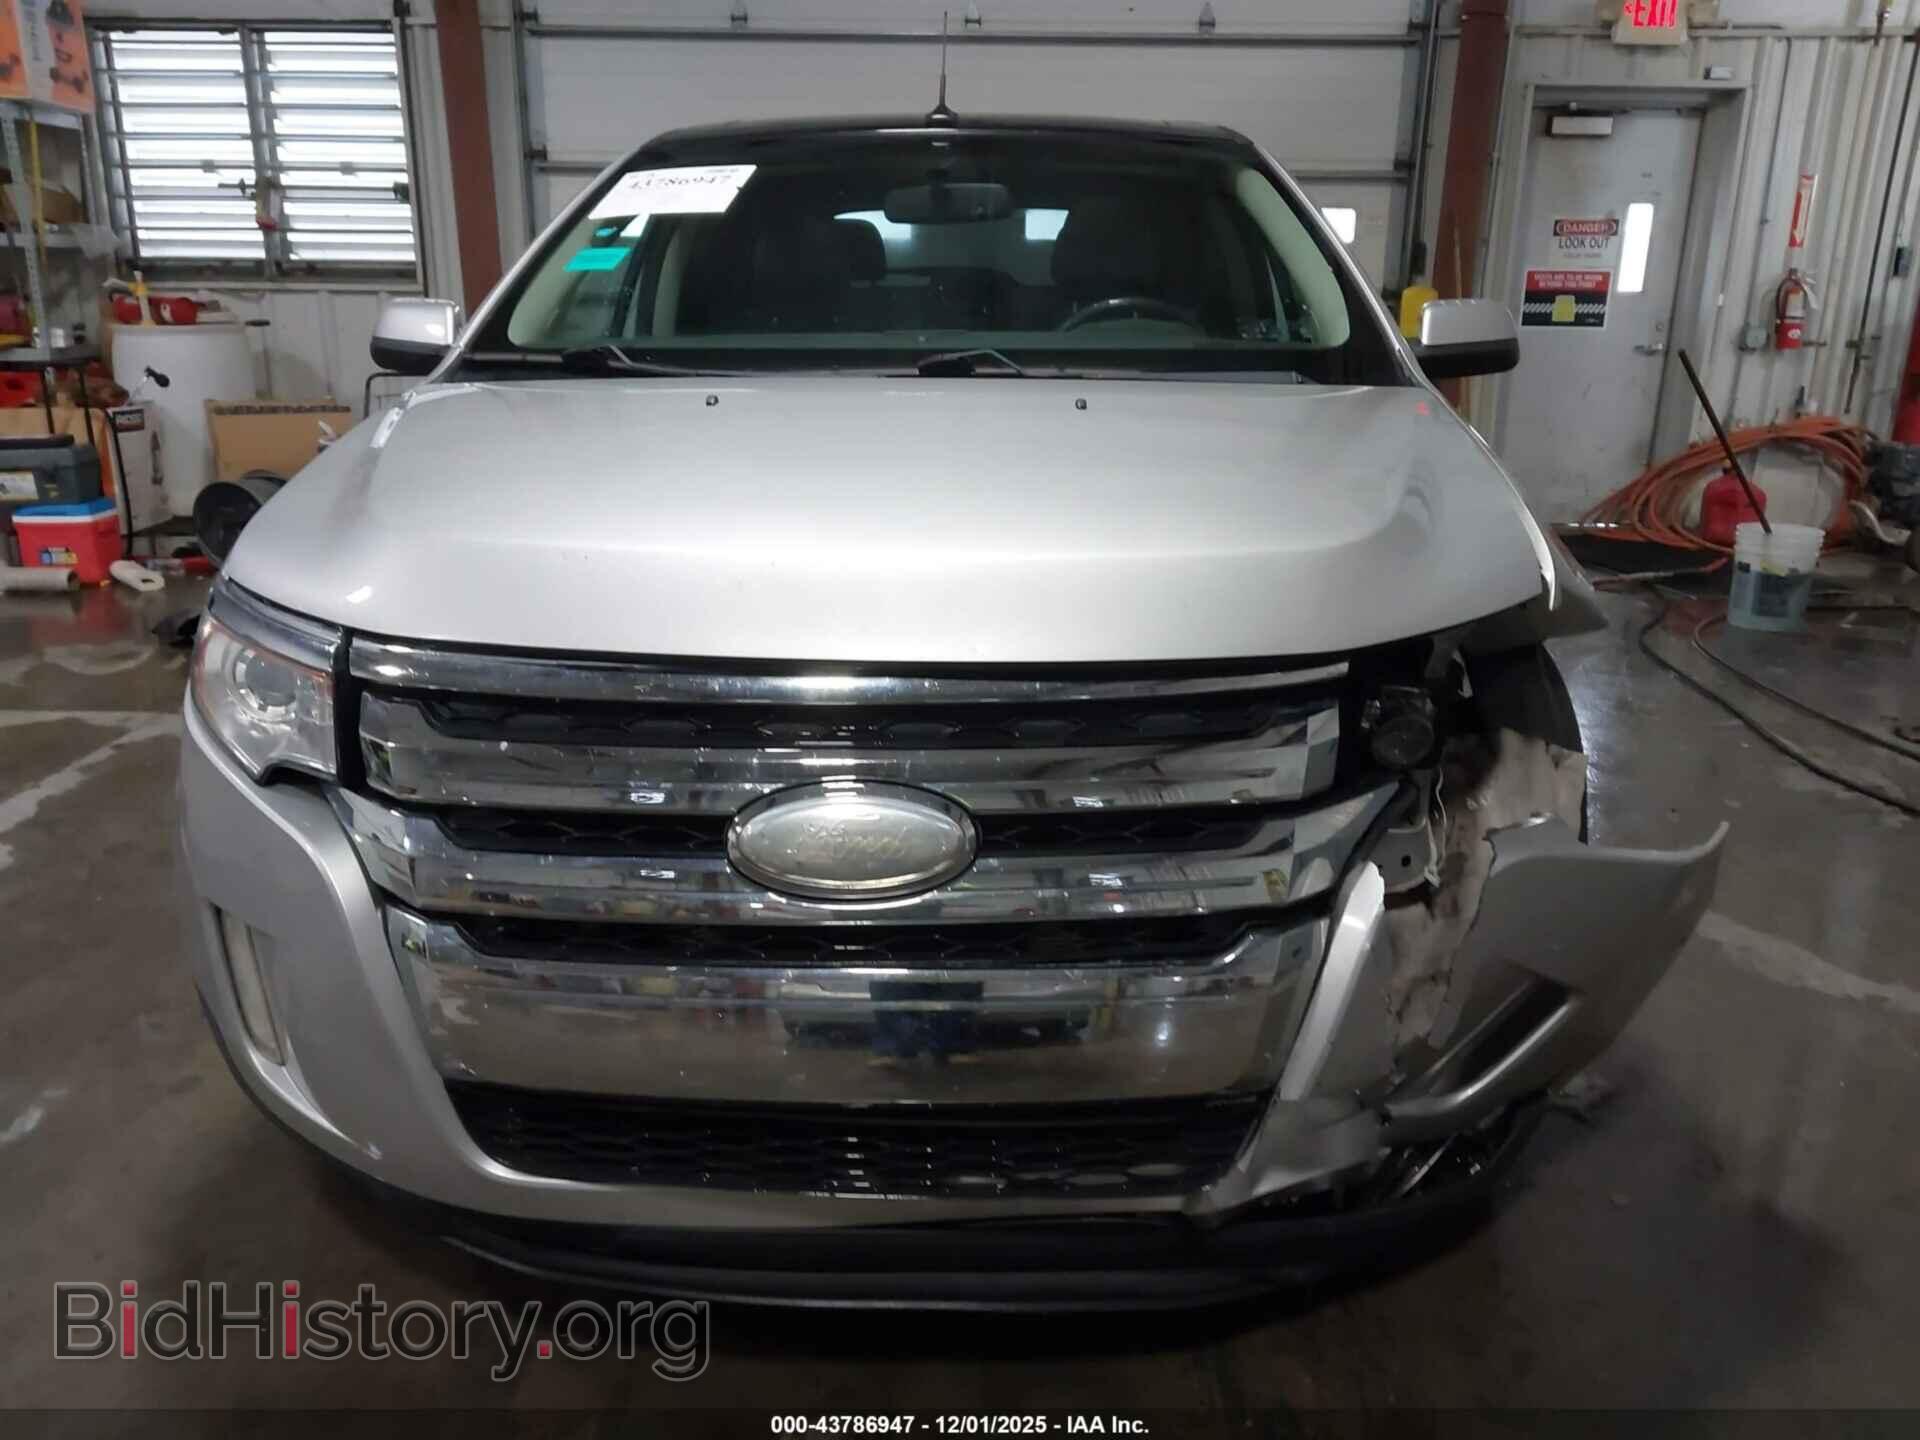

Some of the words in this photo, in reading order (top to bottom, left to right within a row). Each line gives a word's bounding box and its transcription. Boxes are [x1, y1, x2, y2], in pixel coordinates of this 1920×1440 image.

[1632, 0, 1678, 27] EXIT
[1563, 222, 1609, 234] DANGER
[1558, 236, 1586, 249] LOOK
[1589, 236, 1610, 249] OUT
